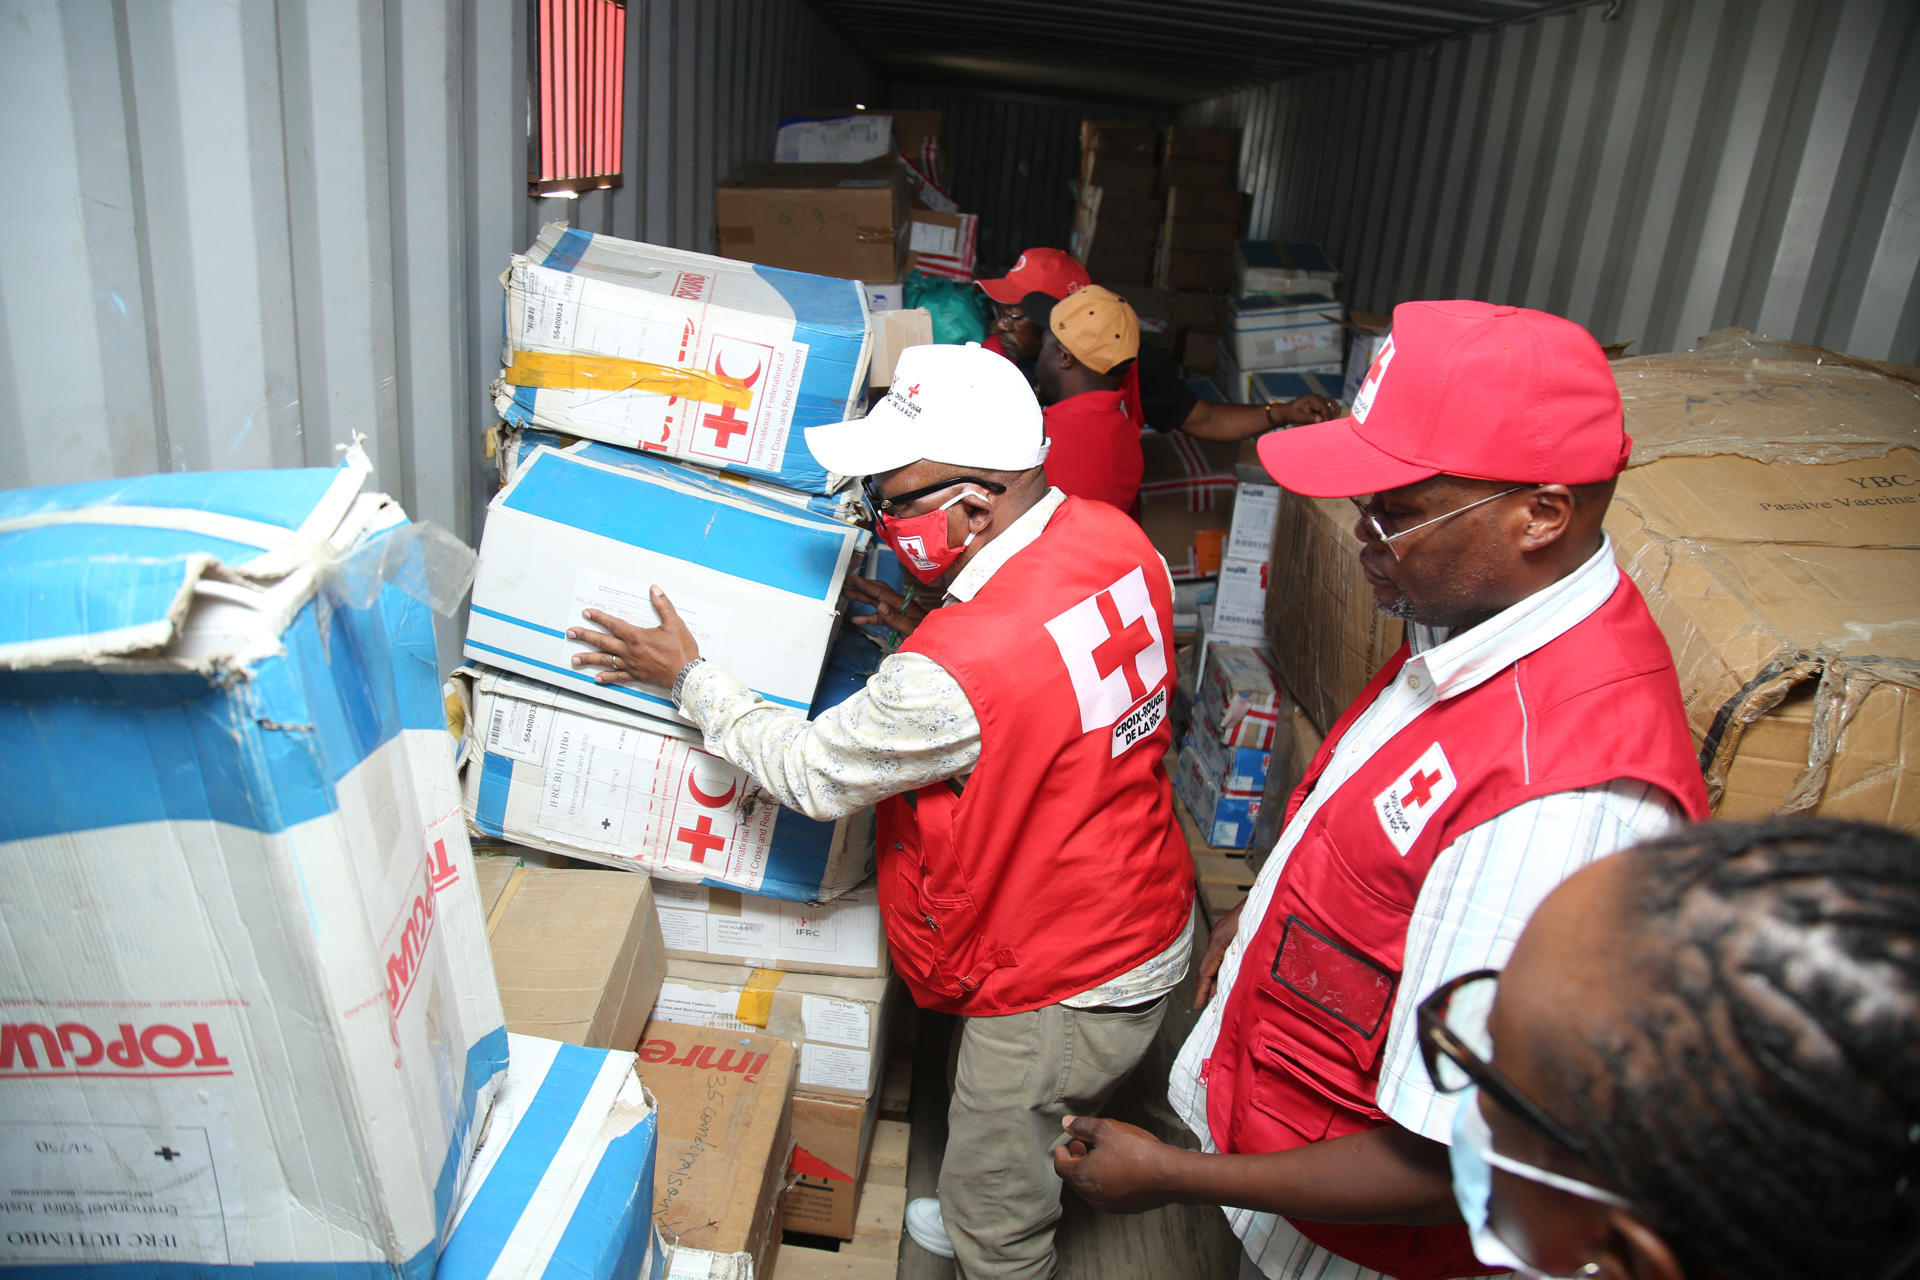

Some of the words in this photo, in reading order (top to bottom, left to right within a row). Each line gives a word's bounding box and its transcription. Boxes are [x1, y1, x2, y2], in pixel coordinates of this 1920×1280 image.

[553, 303, 564, 339] 55400034
[787, 349, 803, 388] Crescent
[753, 411, 772, 461] International
[766, 363, 783, 408] Federation
[777, 352, 785, 361] of
[782, 390, 793, 407] Red
[778, 409, 788, 425] and
[771, 427, 784, 451] Cross
[767, 453, 778, 470] Red
[1760, 497, 1832, 512] Passive
[1833, 494, 1915, 508] Vaccine
[524, 704, 538, 742] 55400033
[1115, 690, 1165, 738] CROIX-ROUGE
[1125, 730, 1137, 746] DE
[1137, 721, 1150, 738] LA
[1148, 708, 1161, 731] RDC
[553, 731, 571, 783] BUTEMBO
[549, 784, 561, 808] IFRC
[569, 776, 582, 815] Emmanuel
[760, 811, 771, 827] Red
[1390, 790, 1411, 832] CROIX-ROUGE
[757, 828, 767, 843] and
[733, 829, 750, 878] International
[751, 844, 764, 869] Cross
[747, 871, 757, 887] Red
[796, 928, 820, 937] IFRC
[706, 1075, 728, 1102] 35
[44, 1202, 84, 1217] Saint
[88, 1203, 179, 1217] Emmanuel
[6, 1231, 120, 1248] BUTEMBO
[128, 1234, 177, 1249] IFRC
